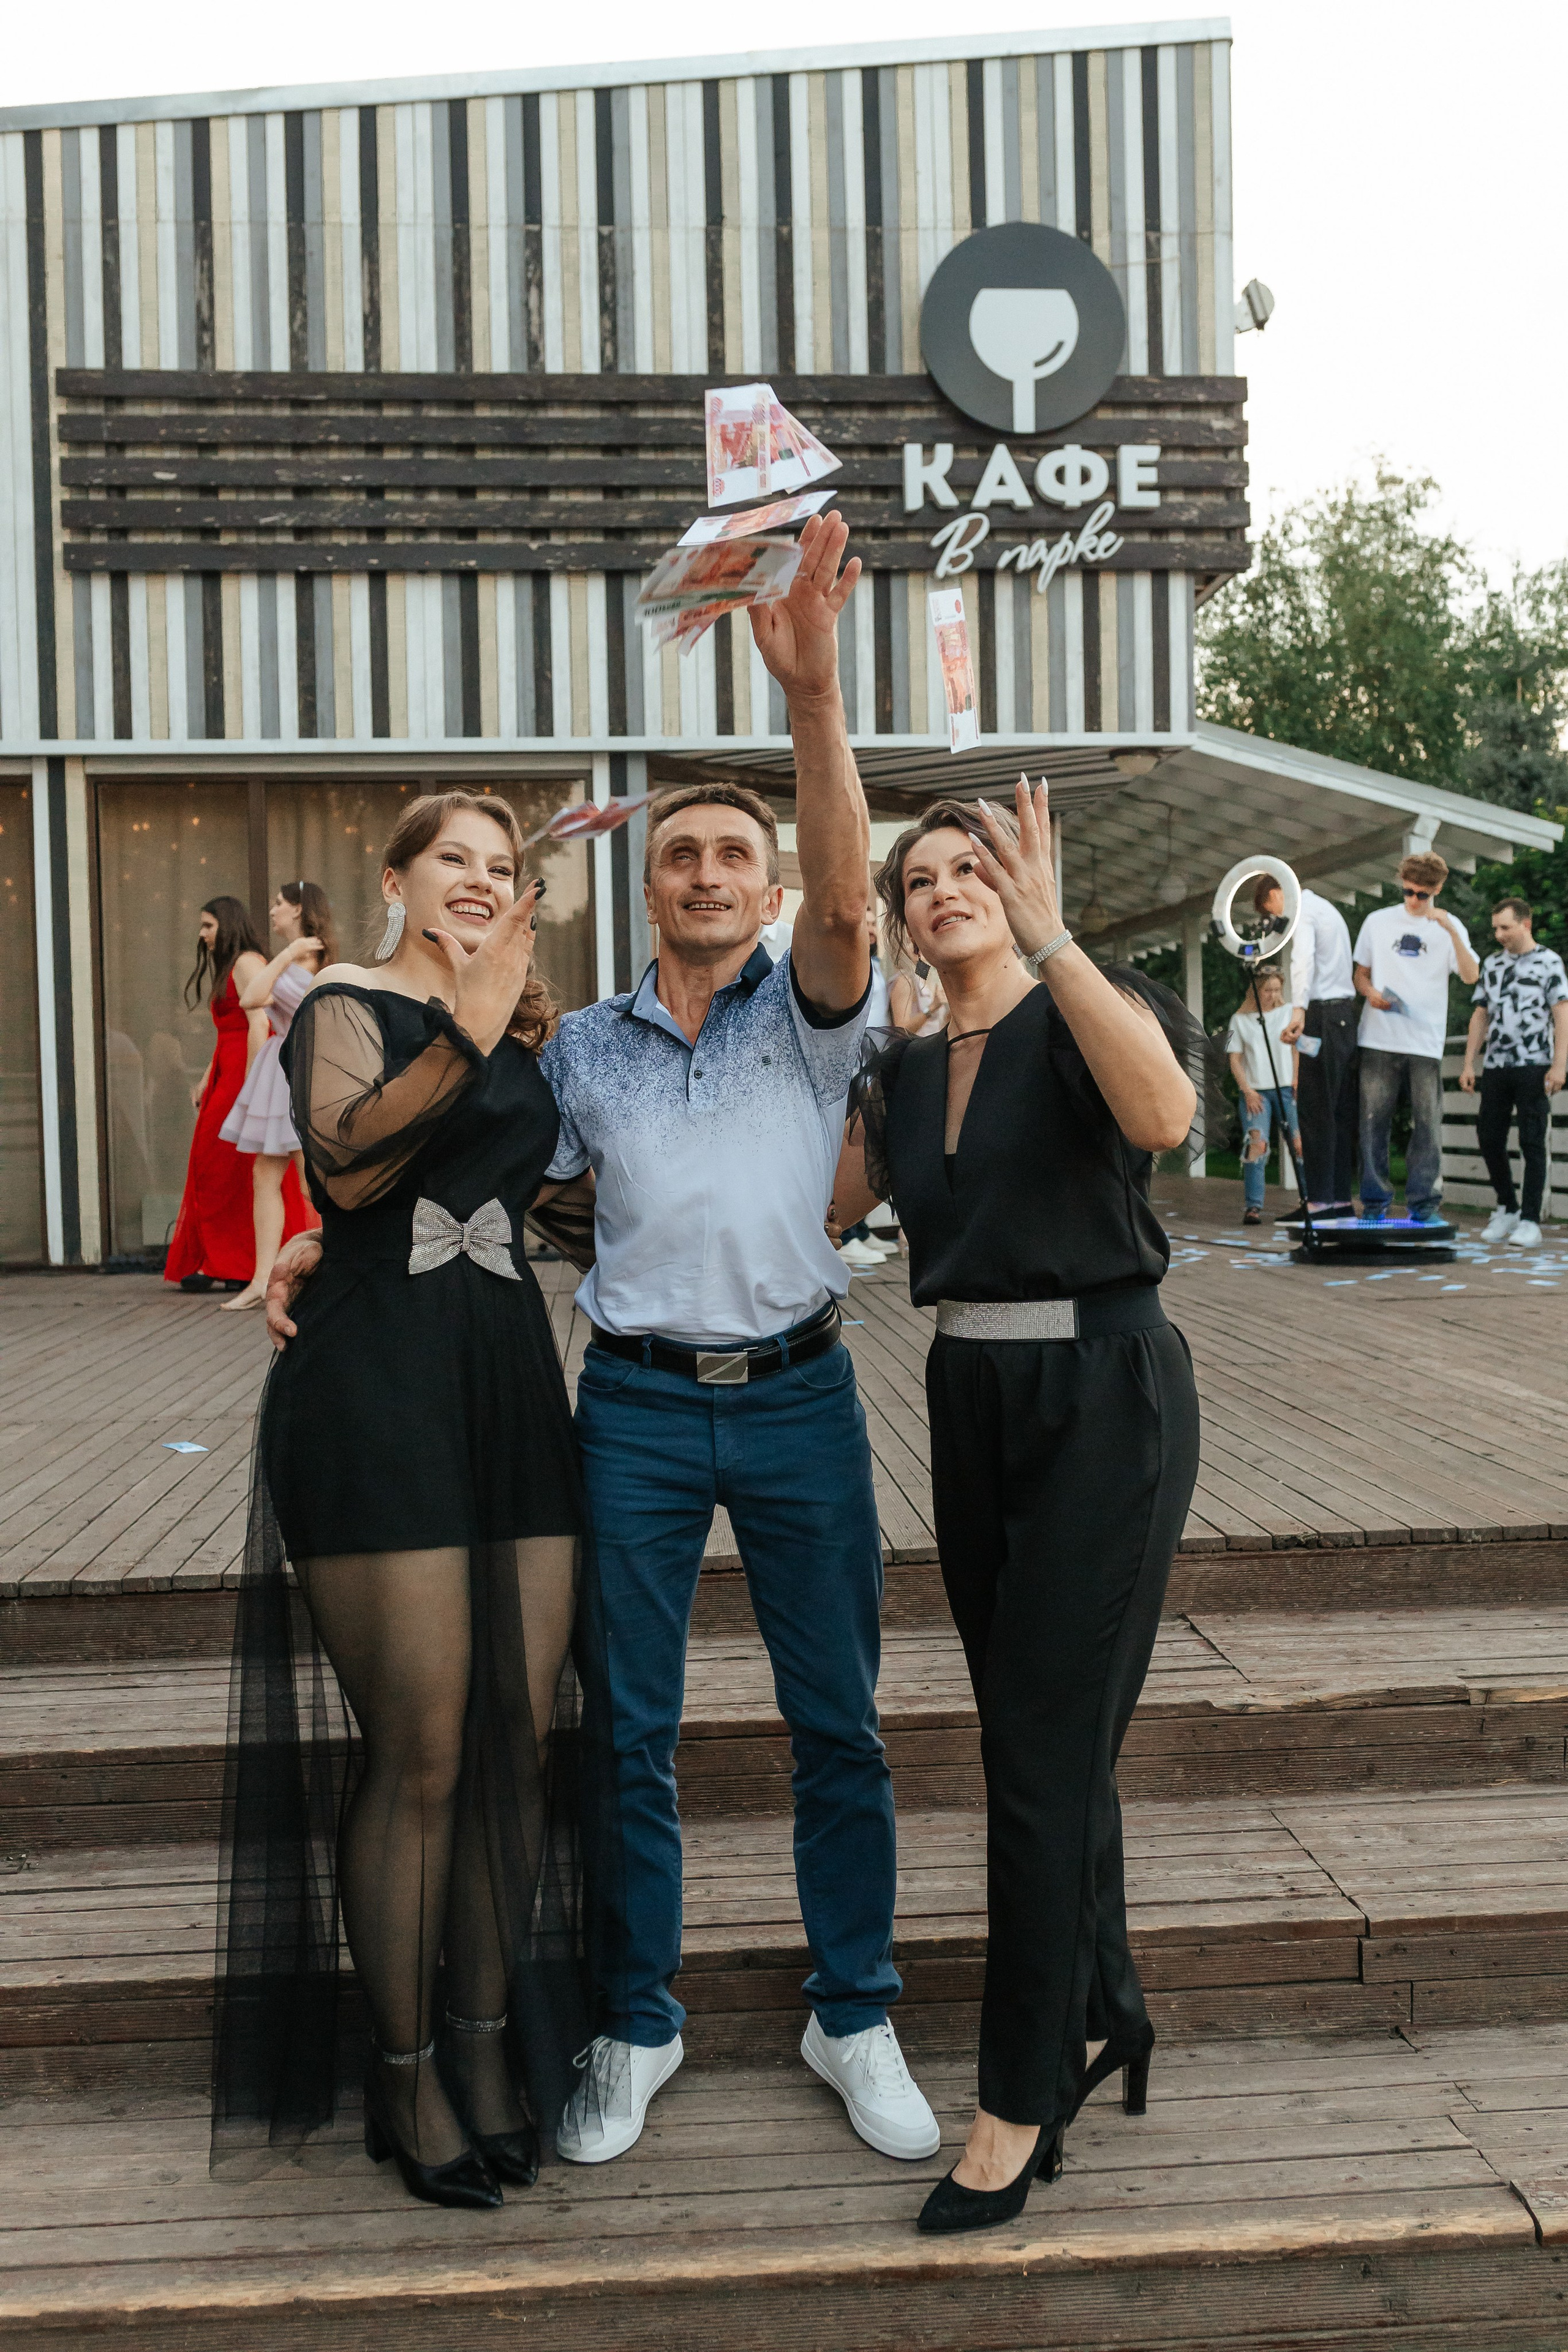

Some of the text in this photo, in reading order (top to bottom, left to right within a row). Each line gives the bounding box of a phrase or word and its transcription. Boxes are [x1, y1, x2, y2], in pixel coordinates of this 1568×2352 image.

[903, 443, 1161, 511] КАФЕ
[930, 501, 1125, 592] В парке
